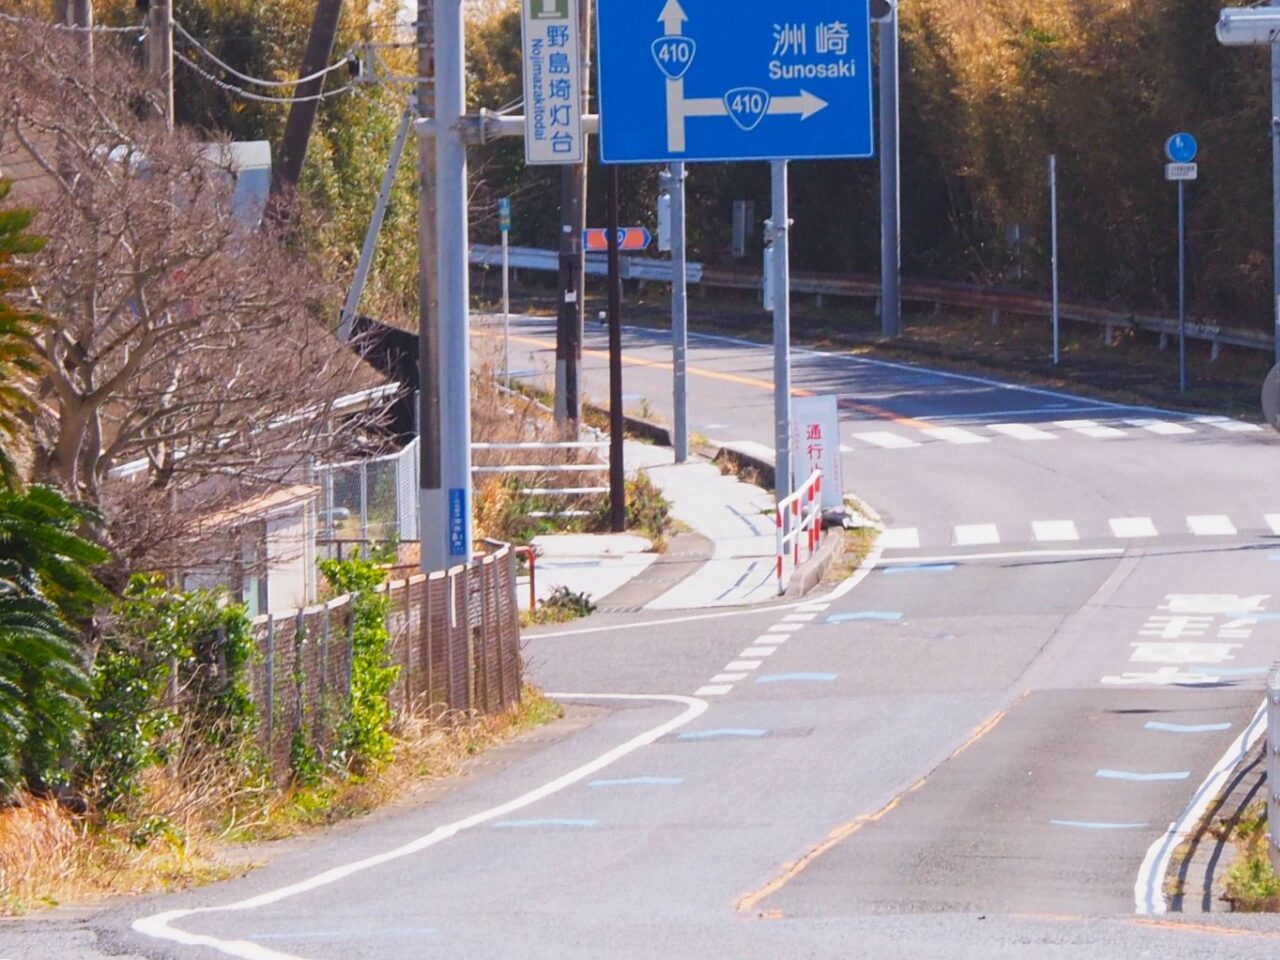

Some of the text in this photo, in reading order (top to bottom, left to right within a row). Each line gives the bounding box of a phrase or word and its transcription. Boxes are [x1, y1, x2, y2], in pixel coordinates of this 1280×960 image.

[772, 21, 849, 56] 洲崎
[659, 43, 689, 63] 410
[768, 58, 856, 80] Sunosaki
[731, 94, 762, 114] 410
